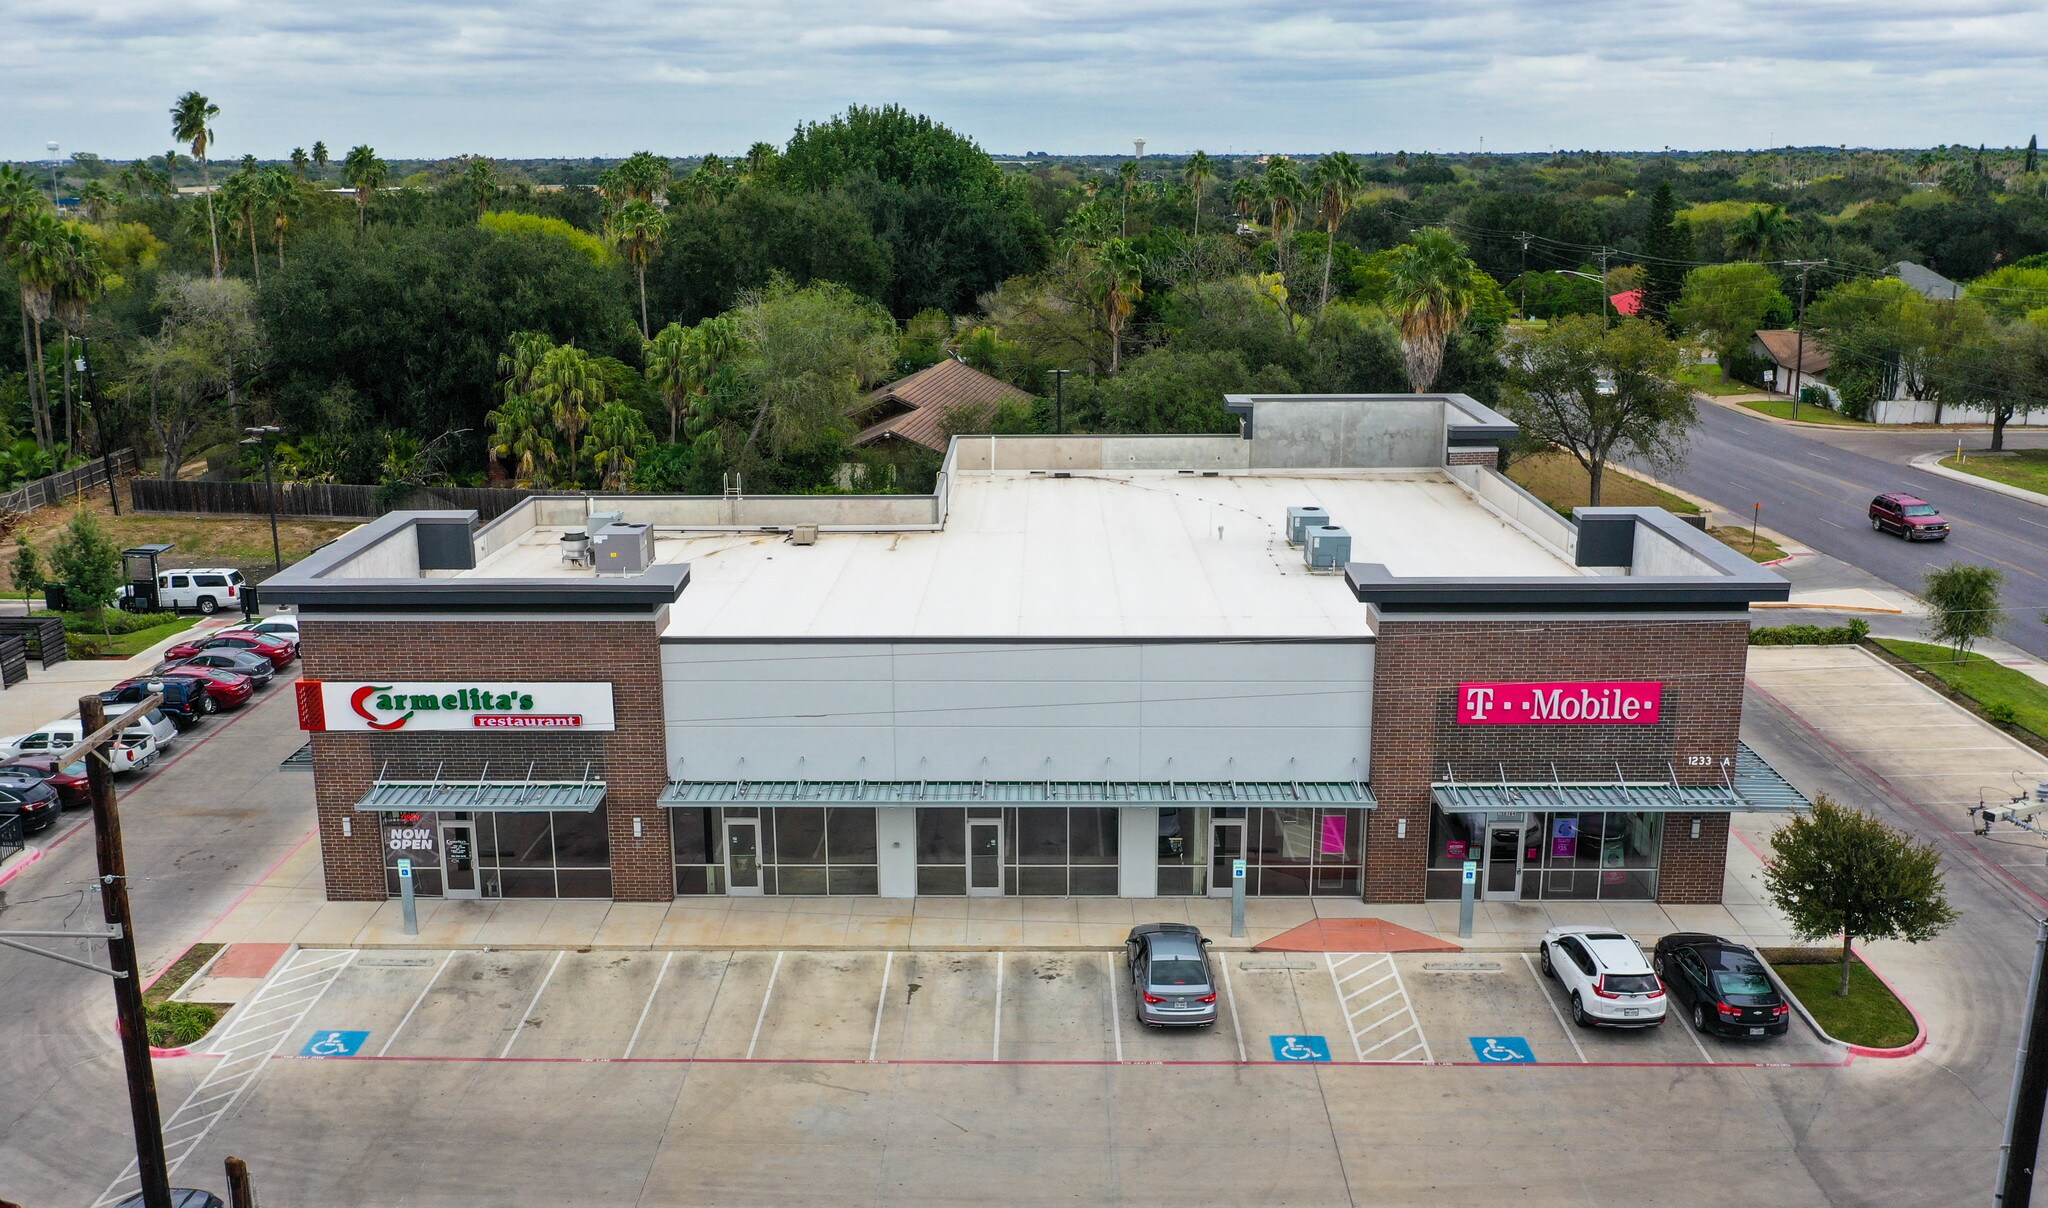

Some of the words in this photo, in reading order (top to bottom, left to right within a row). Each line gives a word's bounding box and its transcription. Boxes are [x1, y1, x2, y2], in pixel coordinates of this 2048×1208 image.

[478, 715, 575, 727] restaurant
[1688, 756, 1712, 766] 1233
[1723, 756, 1730, 766] A
[390, 829, 431, 839] NOW
[389, 839, 433, 850] OPEN
